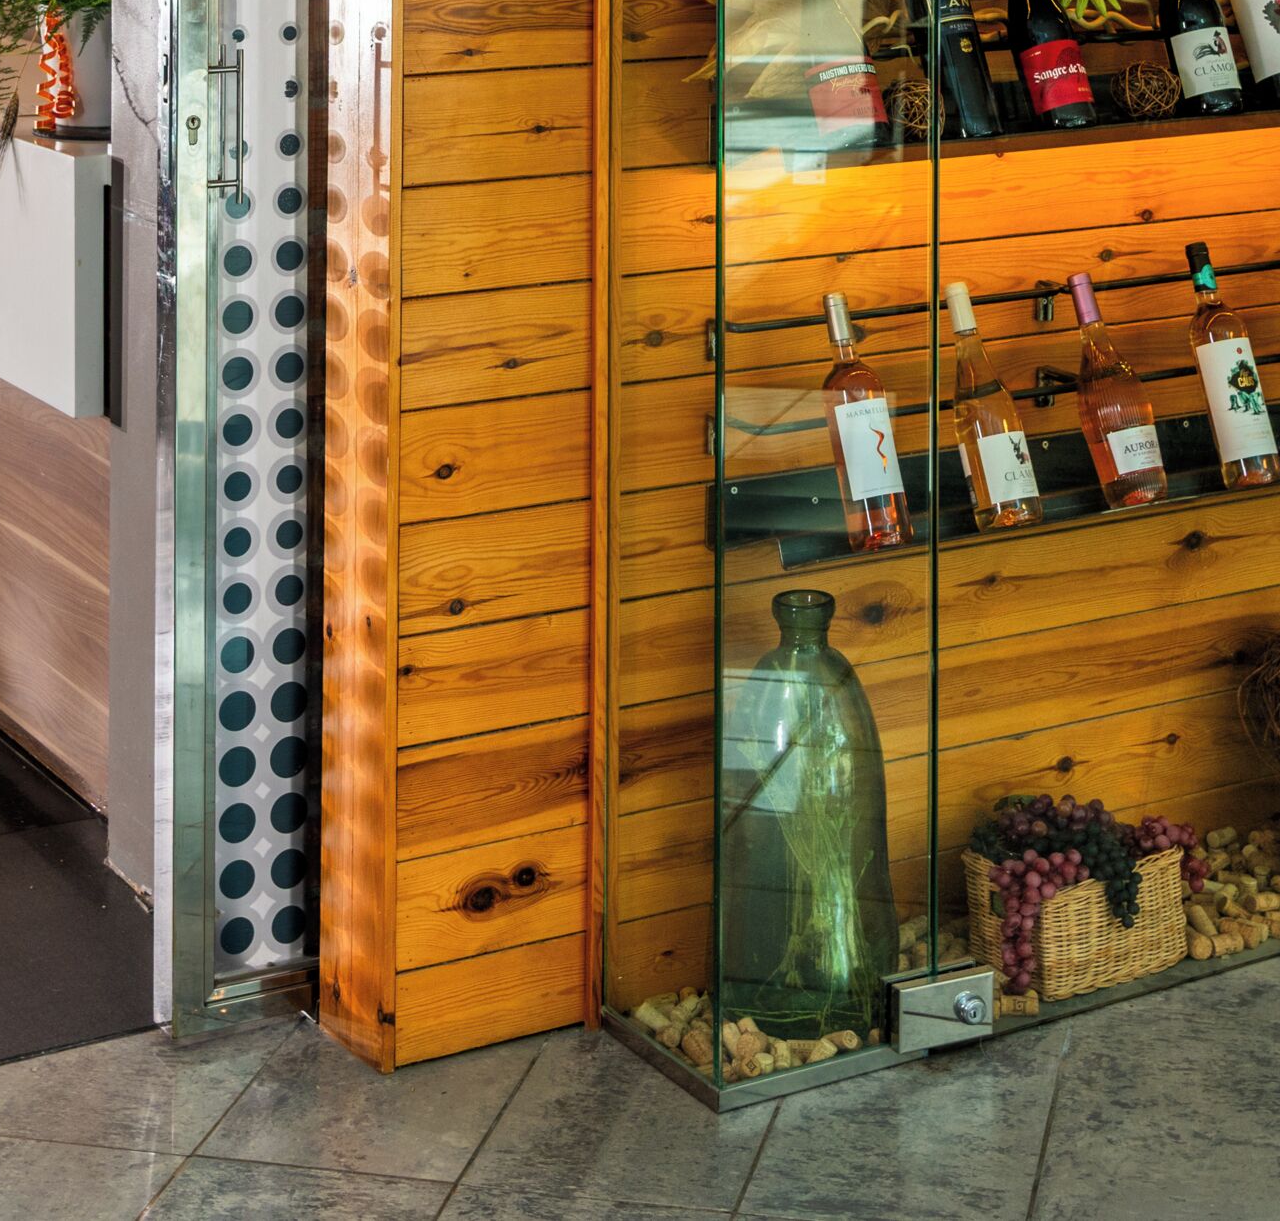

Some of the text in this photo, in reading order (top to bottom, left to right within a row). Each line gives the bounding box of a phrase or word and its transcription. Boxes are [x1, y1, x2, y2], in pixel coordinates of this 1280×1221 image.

[819, 65, 849, 82] FAUSTINO
[1033, 65, 1068, 84] Sangre
[846, 406, 886, 419] MARMELL
[1124, 439, 1159, 455] AUROR
[1004, 469, 1033, 482] CLAM
